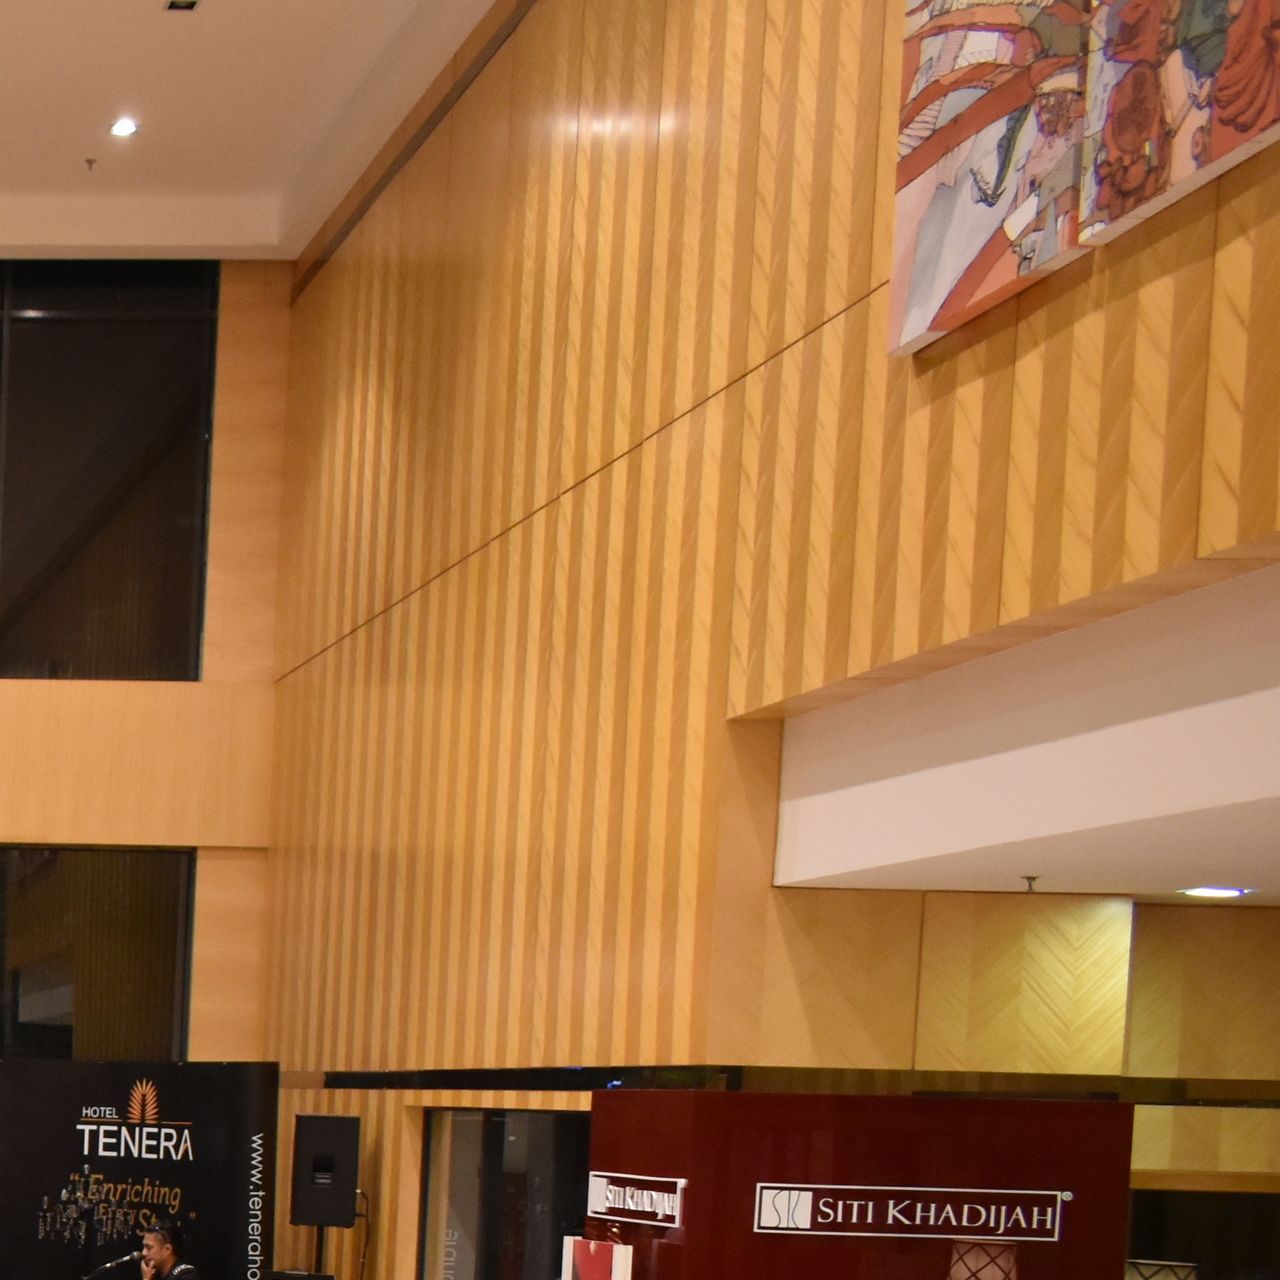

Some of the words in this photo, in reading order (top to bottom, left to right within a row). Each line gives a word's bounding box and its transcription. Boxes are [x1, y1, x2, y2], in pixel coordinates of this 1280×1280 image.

[82, 1106, 119, 1119] HOTEL
[76, 1124, 193, 1161] TENERA
[817, 1197, 874, 1224] SITI
[886, 1199, 1054, 1234] KHADIJAH
